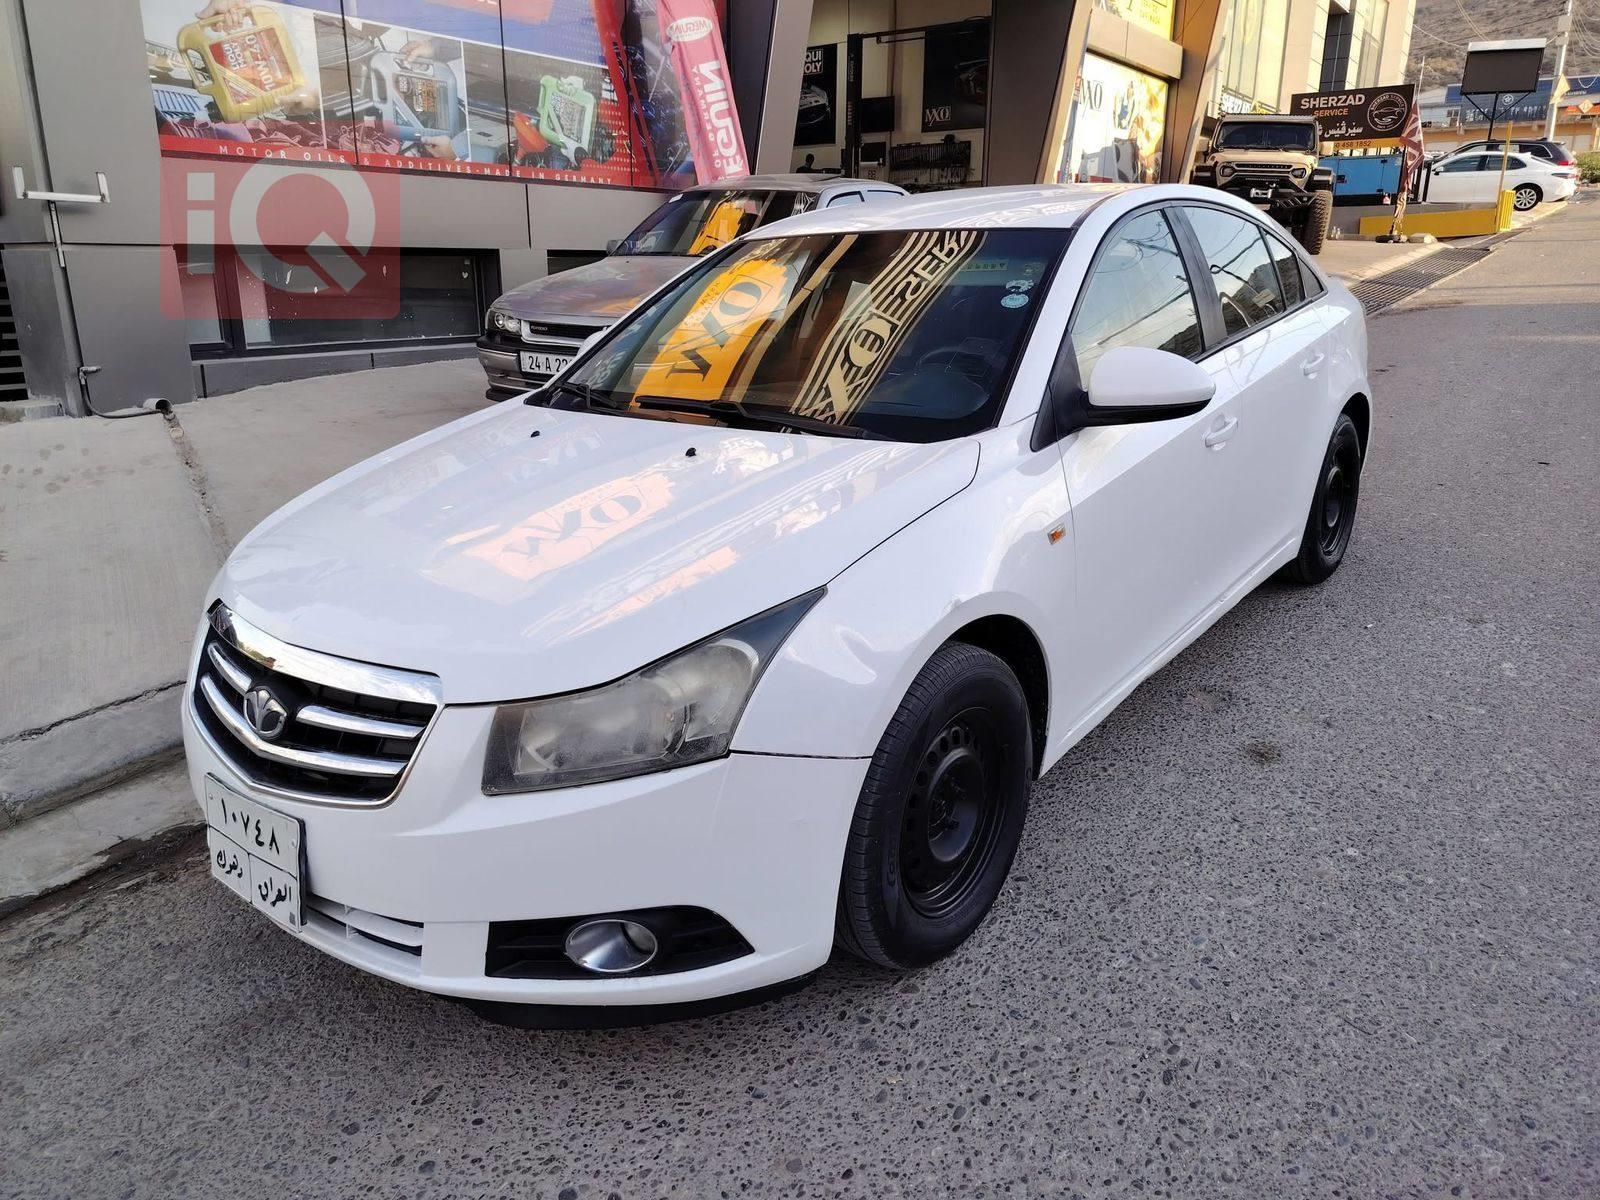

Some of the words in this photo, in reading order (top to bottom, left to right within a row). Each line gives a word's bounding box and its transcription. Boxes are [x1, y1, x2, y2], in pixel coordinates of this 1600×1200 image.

[1300, 93, 1366, 110] SHERZAD
[1313, 108, 1349, 117] SERVICE
[219, 145, 287, 159] MOTOR
[303, 151, 345, 163] OILS
[384, 159, 472, 174] ADDITIVES
[484, 167, 521, 177] MADE
[532, 171, 545, 180] IN
[555, 173, 612, 184] GERMANY
[528, 355, 541, 371] 24
[545, 357, 551, 372] A
[555, 359, 573, 373] 22
[221, 798, 280, 855] ١٠٧٤٨
